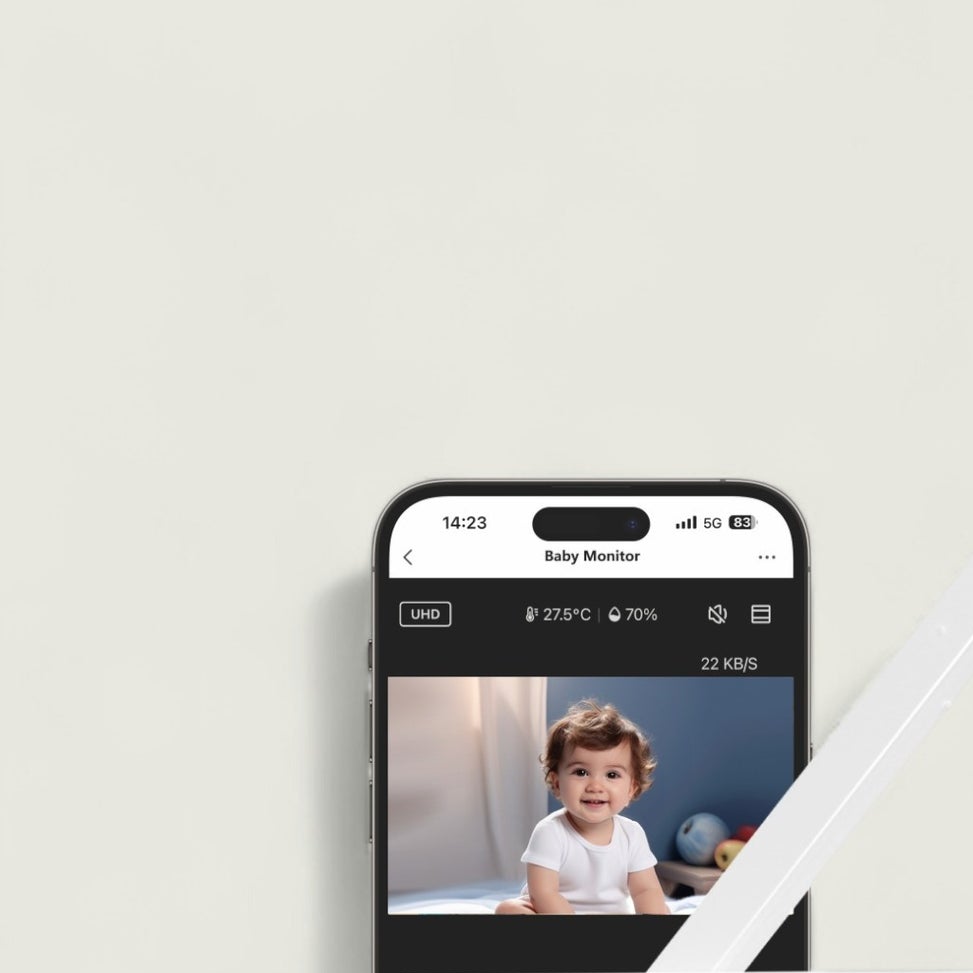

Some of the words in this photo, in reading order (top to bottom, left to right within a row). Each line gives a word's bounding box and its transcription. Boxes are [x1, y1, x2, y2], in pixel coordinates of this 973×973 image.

[442, 516, 488, 530] 14:23
[703, 517, 722, 530] 5G
[733, 517, 752, 528] 83
[544, 550, 580, 566] Baby
[583, 549, 641, 563] Monitor
[410, 608, 441, 621] UHD
[543, 607, 592, 622] 27.5°C
[625, 607, 659, 622] 70%
[701, 657, 719, 671] 22
[723, 656, 758, 672] KB/S
